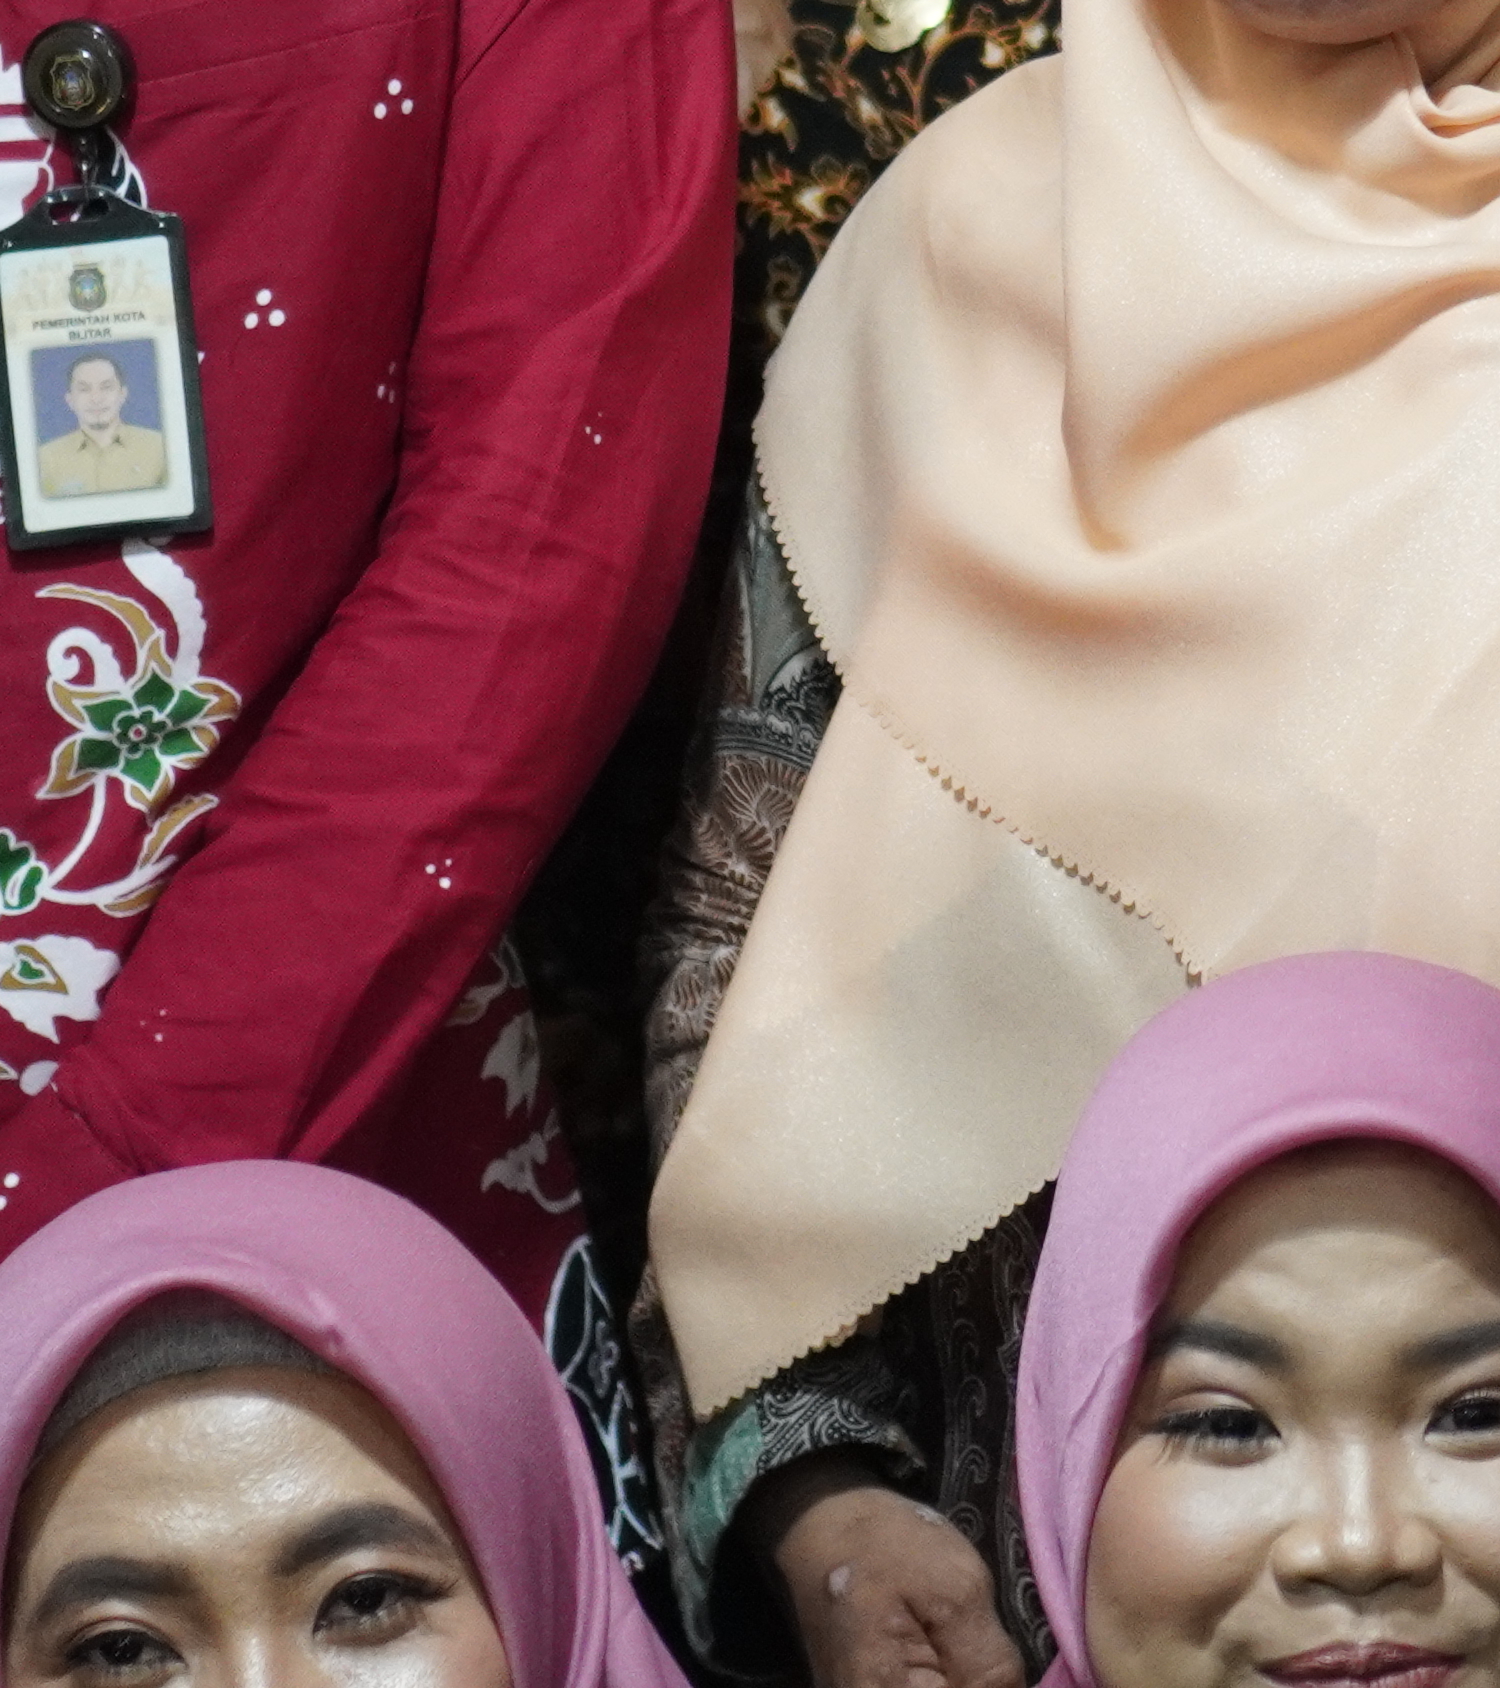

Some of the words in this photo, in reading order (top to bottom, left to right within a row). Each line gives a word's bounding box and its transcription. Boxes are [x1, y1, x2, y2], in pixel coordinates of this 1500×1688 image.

[32, 314, 110, 330] PEMERINTAH
[113, 310, 146, 323] KOTA
[68, 328, 112, 341] BLITAR
